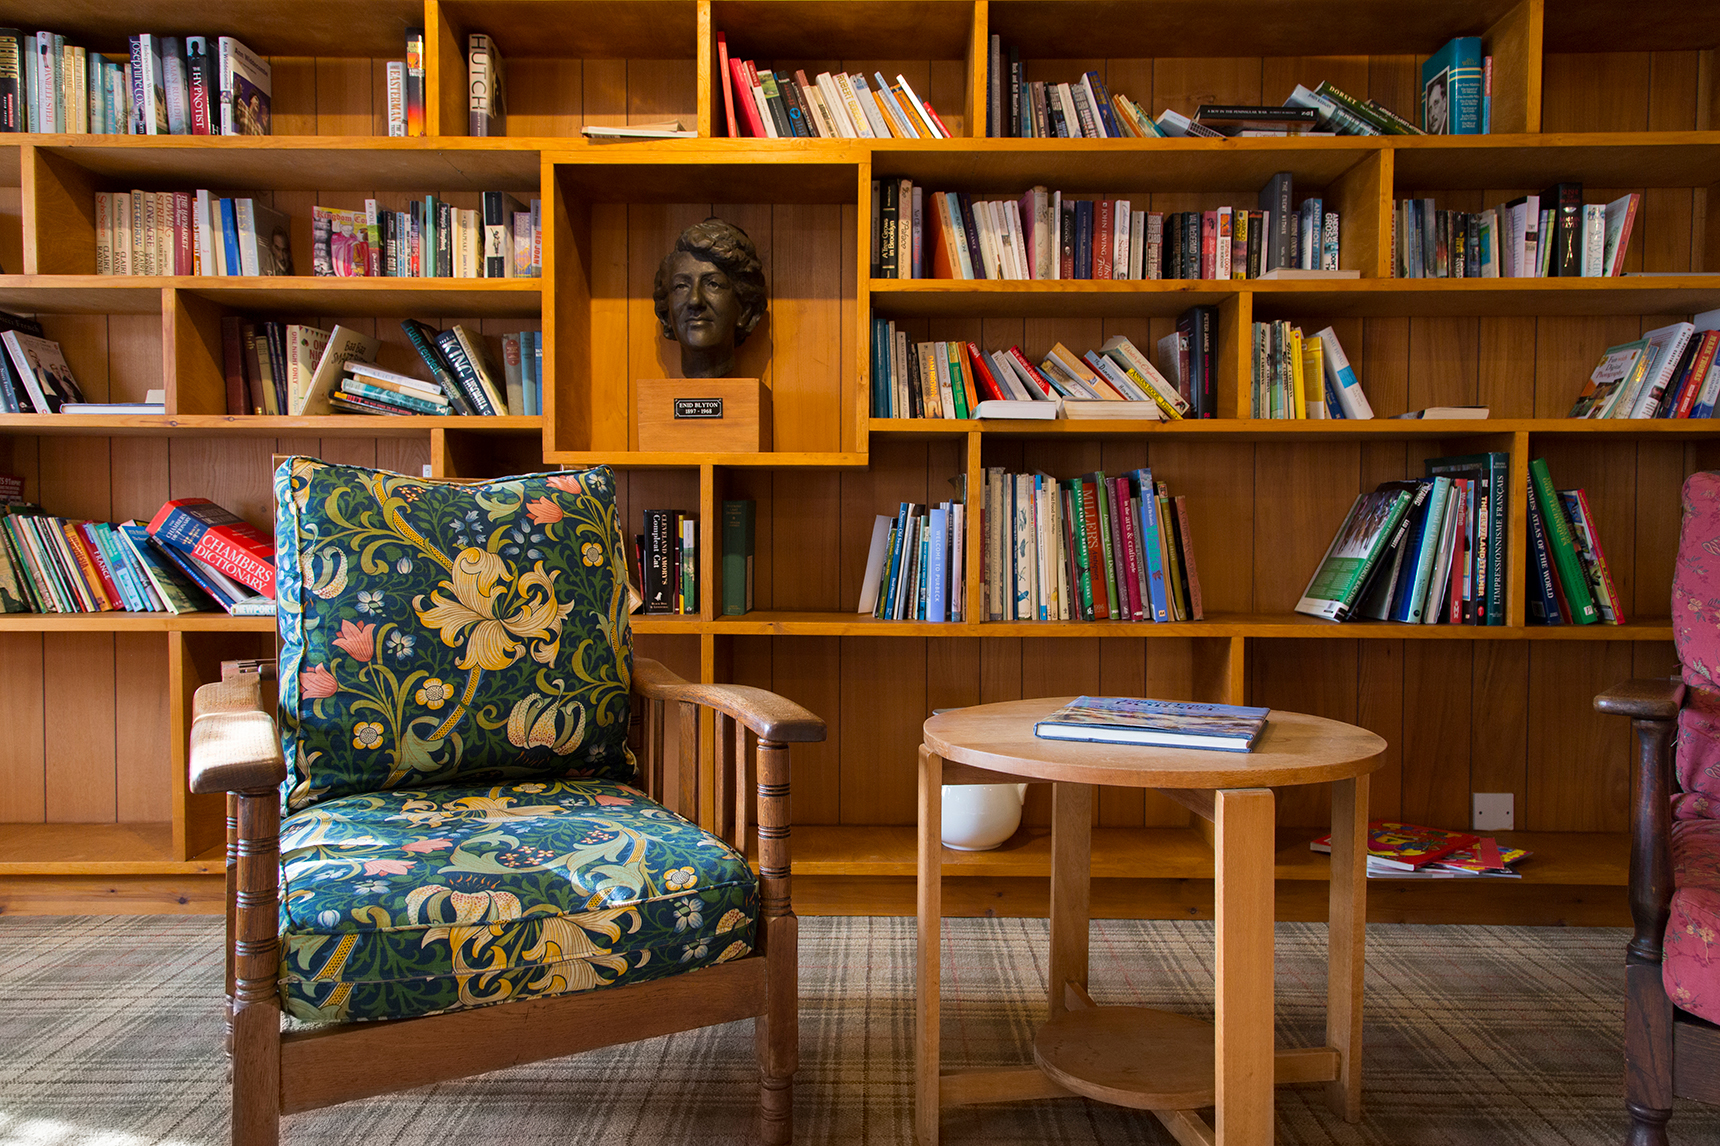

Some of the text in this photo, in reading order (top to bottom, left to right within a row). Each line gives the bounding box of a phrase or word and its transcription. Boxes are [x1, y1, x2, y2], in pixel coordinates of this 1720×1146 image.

[129, 39, 145, 107] Josephine Cox
[169, 52, 182, 122] SALMAN RUSHDIE
[223, 53, 231, 89] Widdecombe
[471, 36, 487, 110] HUTCH
[44, 67, 53, 125] DANIELLE STEEL
[193, 73, 204, 129] HYPNOTIST
[390, 71, 402, 123] EASTERMAN
[837, 75, 868, 132] ROBERT GODDARD
[1012, 94, 1020, 117] Mountains
[1089, 74, 1108, 106] HARRY
[1329, 85, 1358, 105] DORSET
[97, 194, 108, 238] Soho Square
[133, 193, 142, 248] BEDFORD ROW
[146, 200, 155, 248] LONG ACRE
[156, 194, 165, 234] STREET
[165, 195, 174, 237] GOWER
[181, 210, 189, 250] HAYMARKET
[237, 205, 248, 237] BEST
[317, 210, 352, 222] Kingdom
[1188, 214, 1198, 225] VAL
[1280, 215, 1288, 235] WITHIN
[1324, 213, 1333, 243] GROSS
[1331, 213, 1339, 244] ANDREW
[411, 224, 419, 257] NUMBERS
[533, 230, 542, 265] RED JOAN
[900, 220, 910, 250] Palace
[912, 209, 921, 265] No No Dagger
[969, 229, 977, 249] FRANCE
[1100, 208, 1109, 256] JOHN IRVING
[1290, 214, 1298, 257] CATHERINE COOKSON
[1312, 227, 1320, 249] HOLT
[1593, 222, 1603, 253] CATHY
[1096, 256, 1106, 277] FIND
[291, 331, 299, 345] ONE
[406, 326, 442, 375] ruth rendell
[291, 346, 299, 366] NIGHT
[441, 338, 473, 378] KING
[920, 352, 928, 363] THE
[940, 359, 948, 380] Roberts
[1098, 363, 1115, 382] Dinner
[1123, 343, 1159, 383] Water Elephants
[1693, 334, 1718, 382] MARK THOMAS
[462, 376, 488, 411] INSOMNIA
[926, 355, 938, 398] DAN BROWN
[1542, 476, 1552, 497] GOLF
[165, 513, 188, 538] CHAMBERS
[898, 510, 906, 528] Discover
[1082, 489, 1099, 550] MILLER'S
[1457, 492, 1467, 527] Waterline
[170, 516, 192, 541] DICTIONARY
[651, 514, 662, 568] Compleat Cat
[894, 537, 902, 555] Swanage
[1114, 530, 1123, 558] GERTRUDE
[1421, 486, 1447, 572] The World of Fly-fishing
[1477, 495, 1489, 597] THE STEAMER
[1493, 474, 1505, 605] L'IMPRESSIONNISME FRANÇAIS
[1527, 485, 1554, 598] TIMES ATLAS OF THE WORLD
[202, 534, 274, 582] CHAMBERS
[660, 514, 669, 586] CLEVELAND AMORY'S
[1126, 540, 1136, 562] crafts
[1146, 525, 1161, 573] Walks
[1180, 517, 1191, 557] CHRISTMAS
[1186, 558, 1195, 578] CAROL
[93, 550, 111, 581] FRANCE
[195, 545, 268, 591] DICTIONARY
[935, 563, 942, 572] TO
[1091, 550, 1100, 581] Antiques
[1107, 559, 1115, 584] DORSET
[1117, 560, 1125, 577] JEKYLL
[1129, 562, 1137, 574] style
[1345, 560, 1373, 604] HORSE RACING
[934, 574, 942, 603] PURBECK
